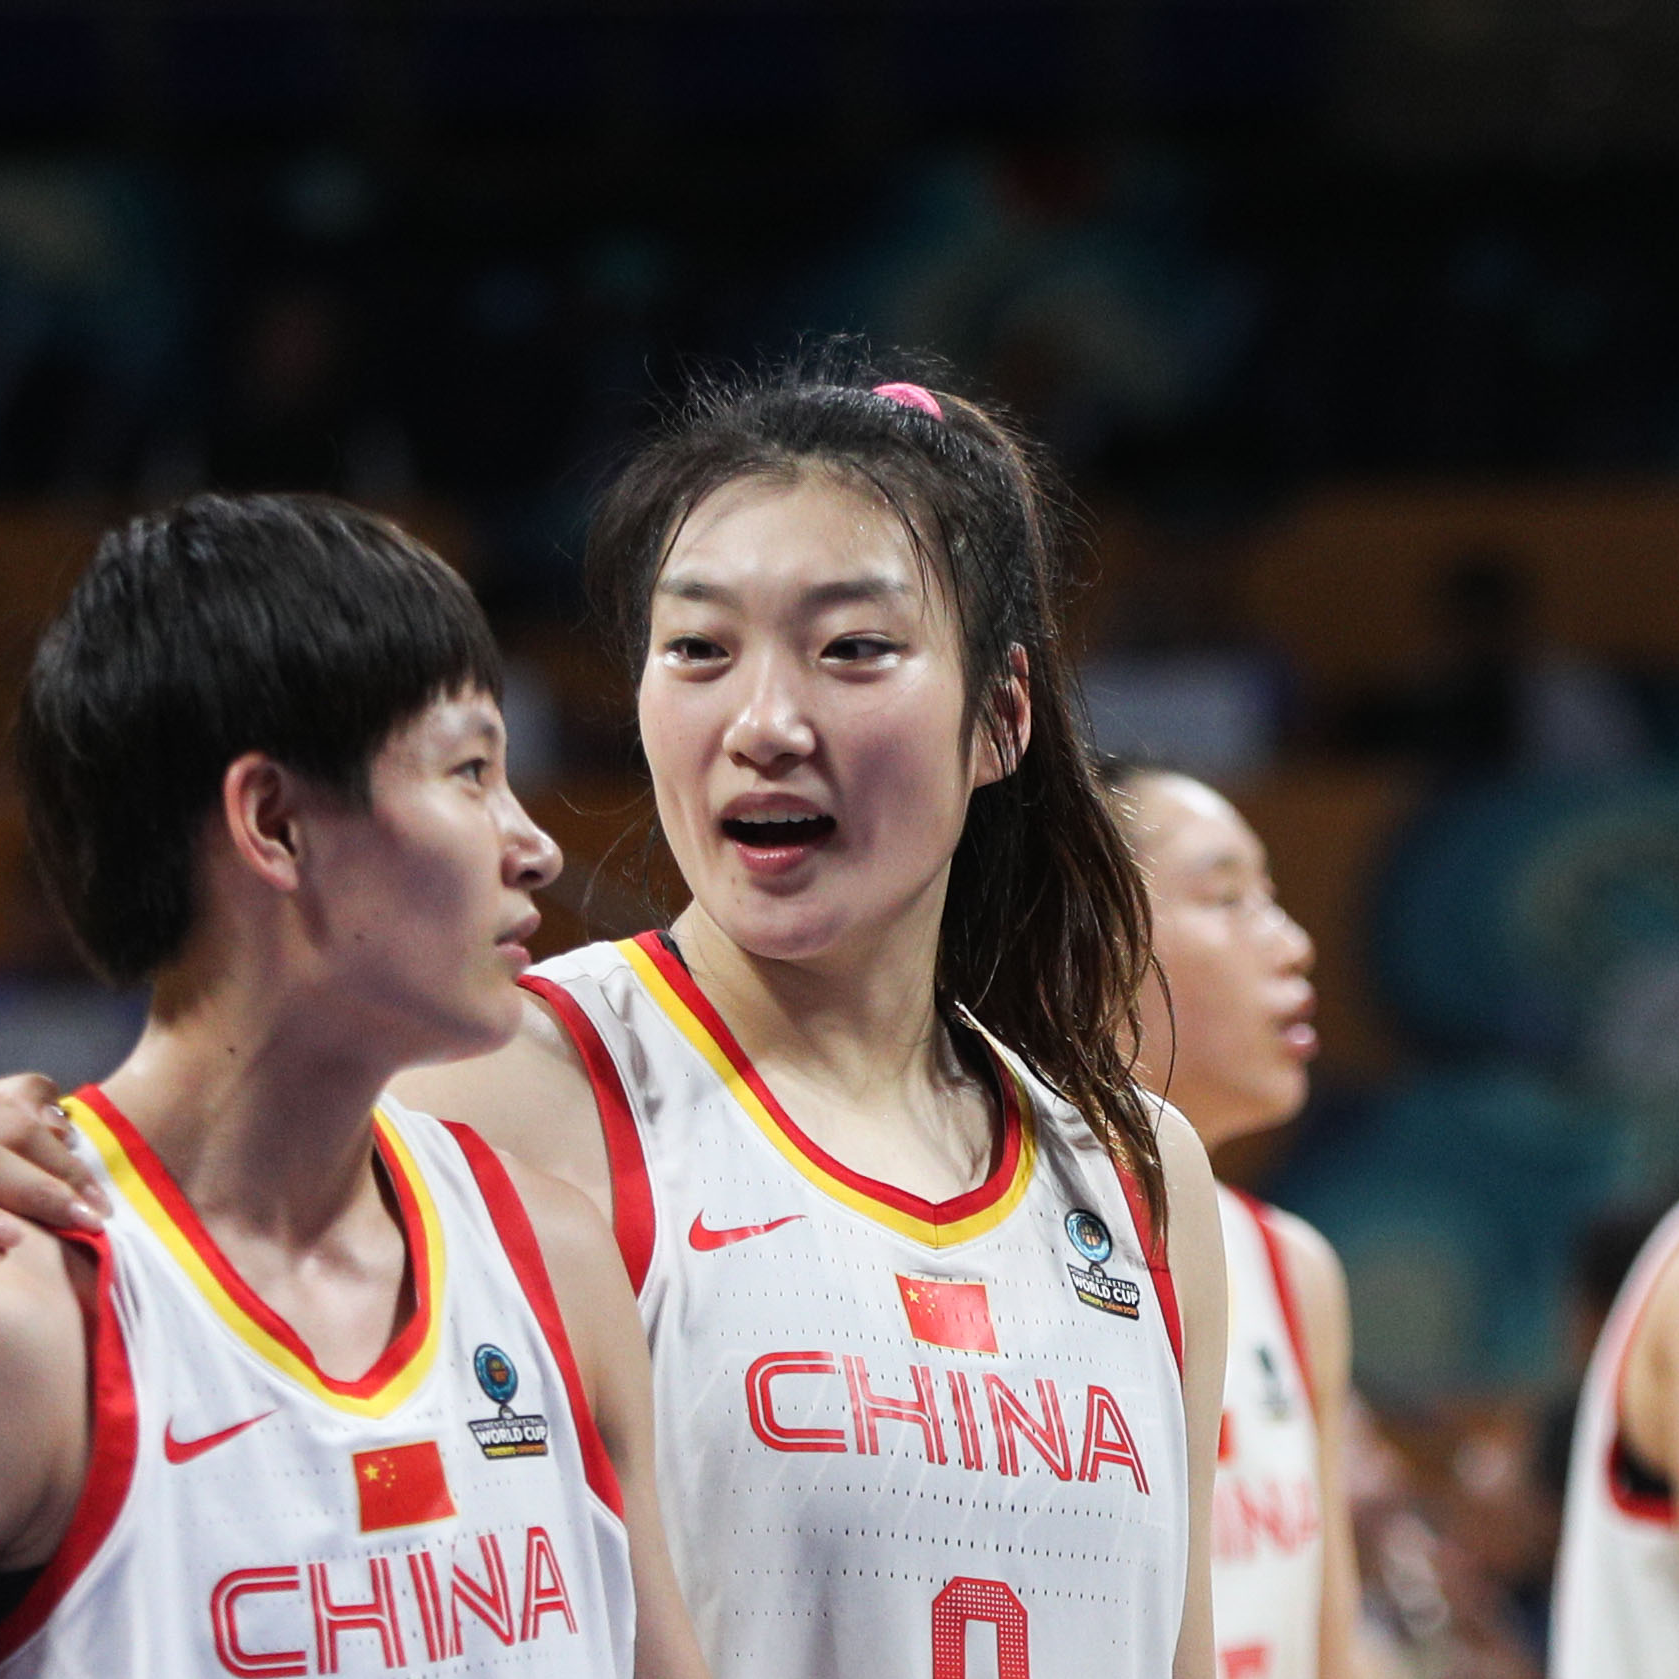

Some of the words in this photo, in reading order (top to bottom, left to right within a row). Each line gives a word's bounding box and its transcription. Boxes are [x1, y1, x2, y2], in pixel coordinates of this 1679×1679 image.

[1072, 1274, 1111, 1300] WORLD
[1113, 1287, 1138, 1305] CUP
[475, 1427, 523, 1445] WORLD
[524, 1425, 546, 1441] CUP
[745, 1351, 1150, 1496] CHINA
[210, 1526, 579, 1679] CHINA
